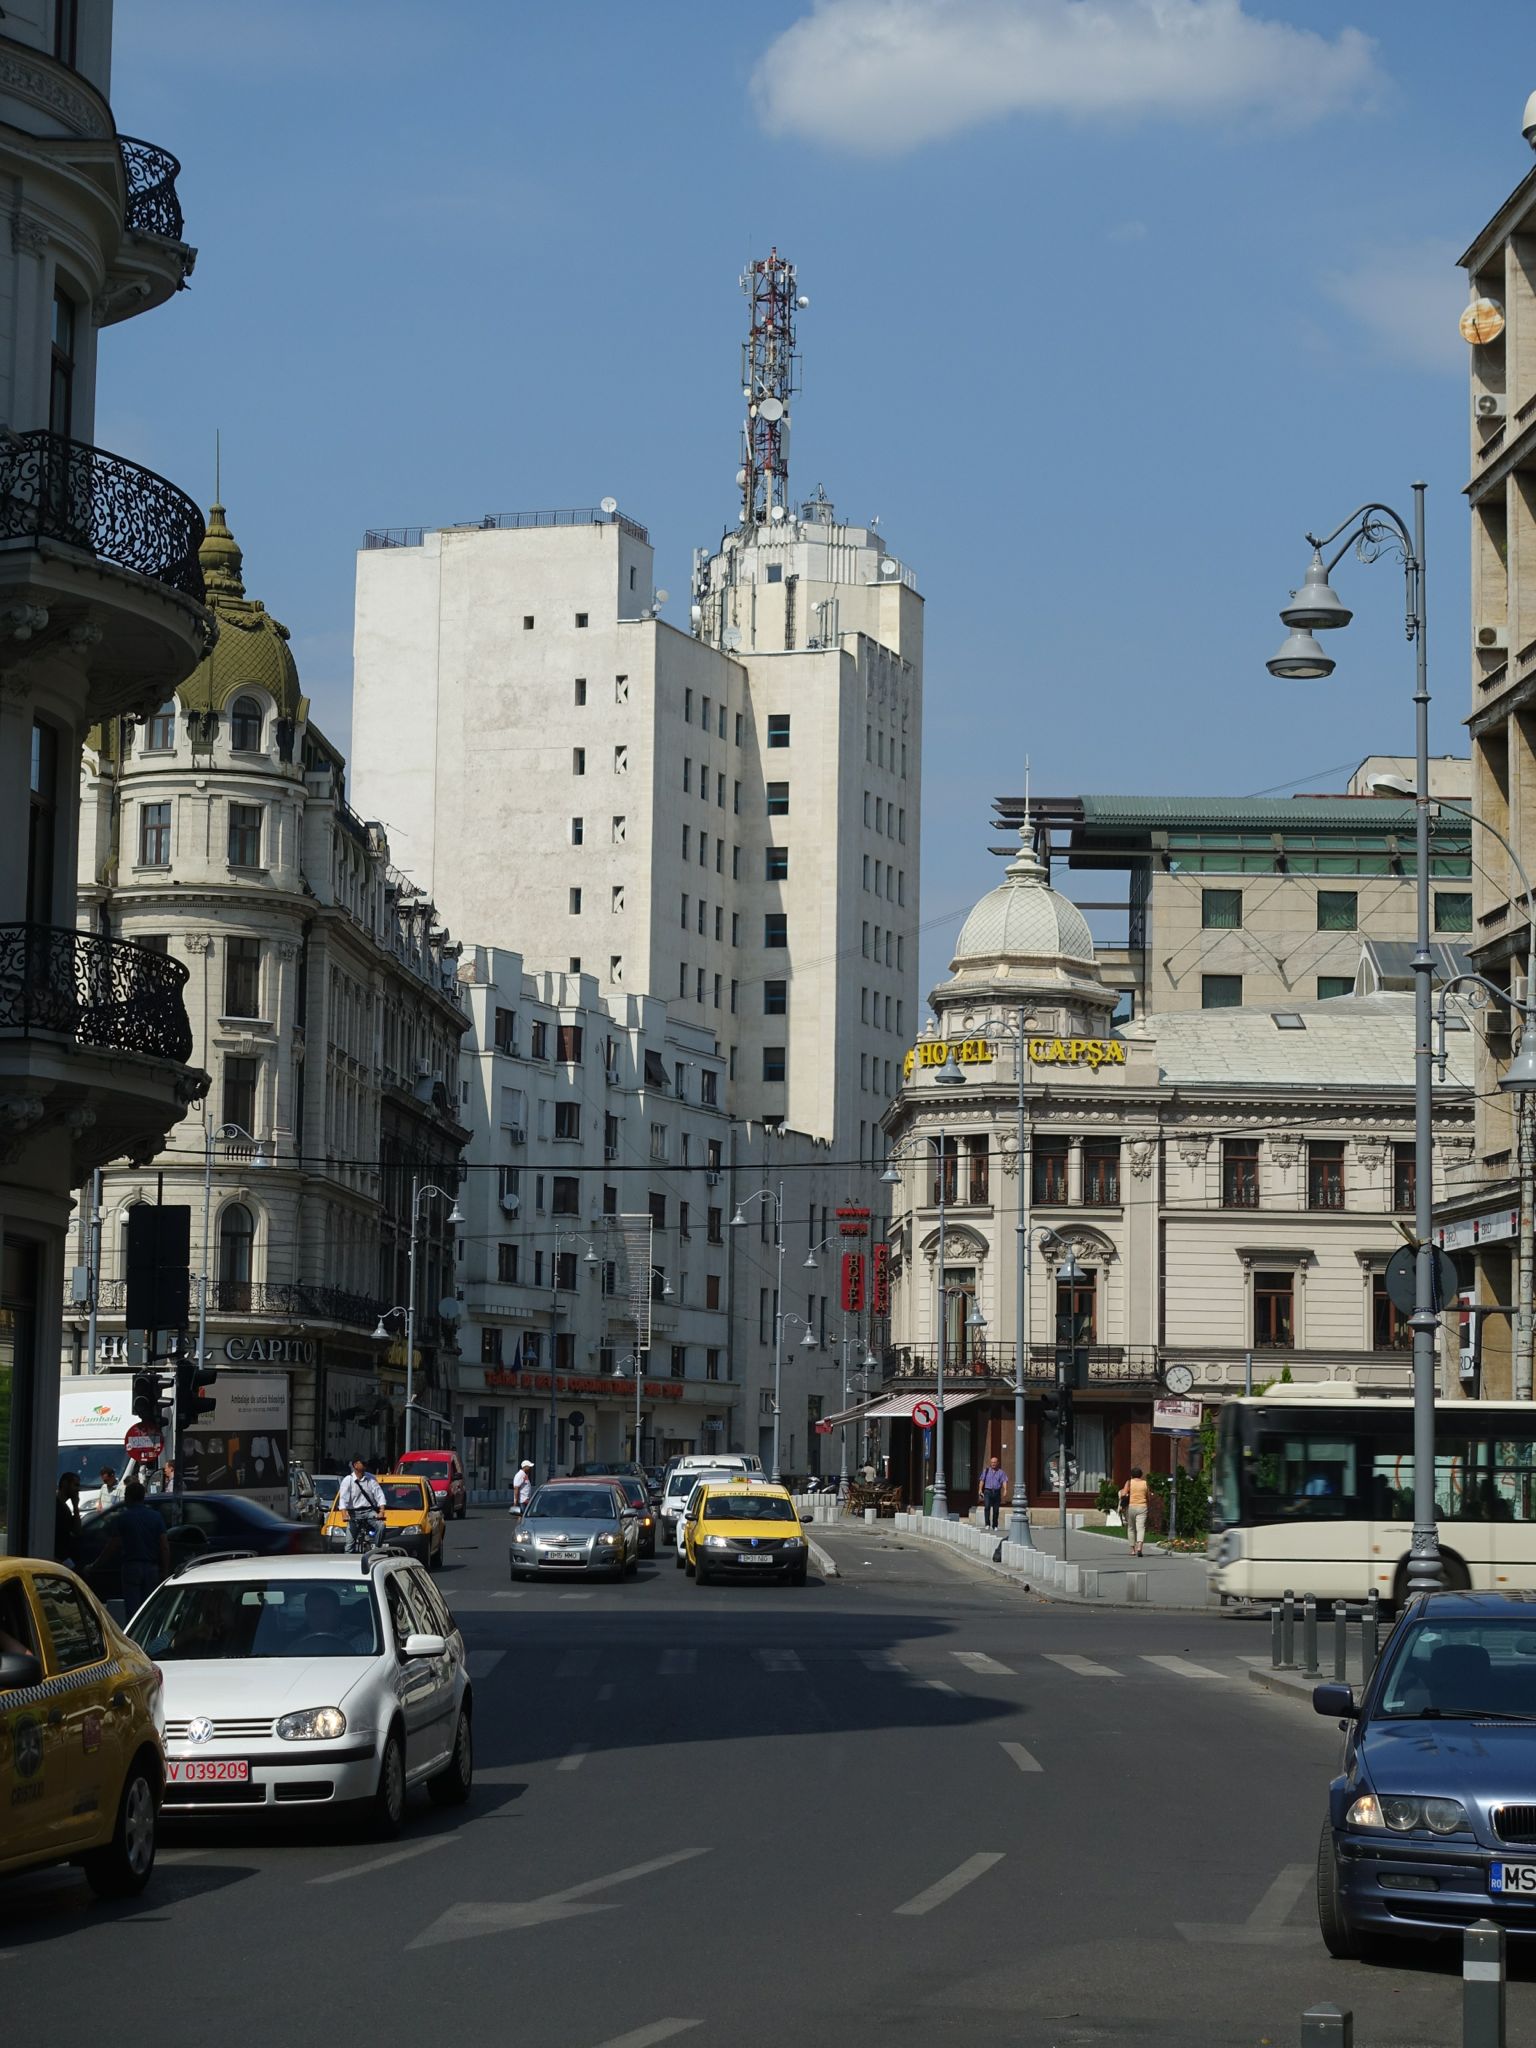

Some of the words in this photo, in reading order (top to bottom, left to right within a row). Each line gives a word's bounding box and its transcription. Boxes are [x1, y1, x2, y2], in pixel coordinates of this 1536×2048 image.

[919, 1040, 993, 1065] HOEL
[848, 1253, 859, 1312] HOTEL
[99, 1335, 213, 1361] HEL
[185, 1762, 248, 1780] 039209
[1491, 1878, 1502, 1889] RO
